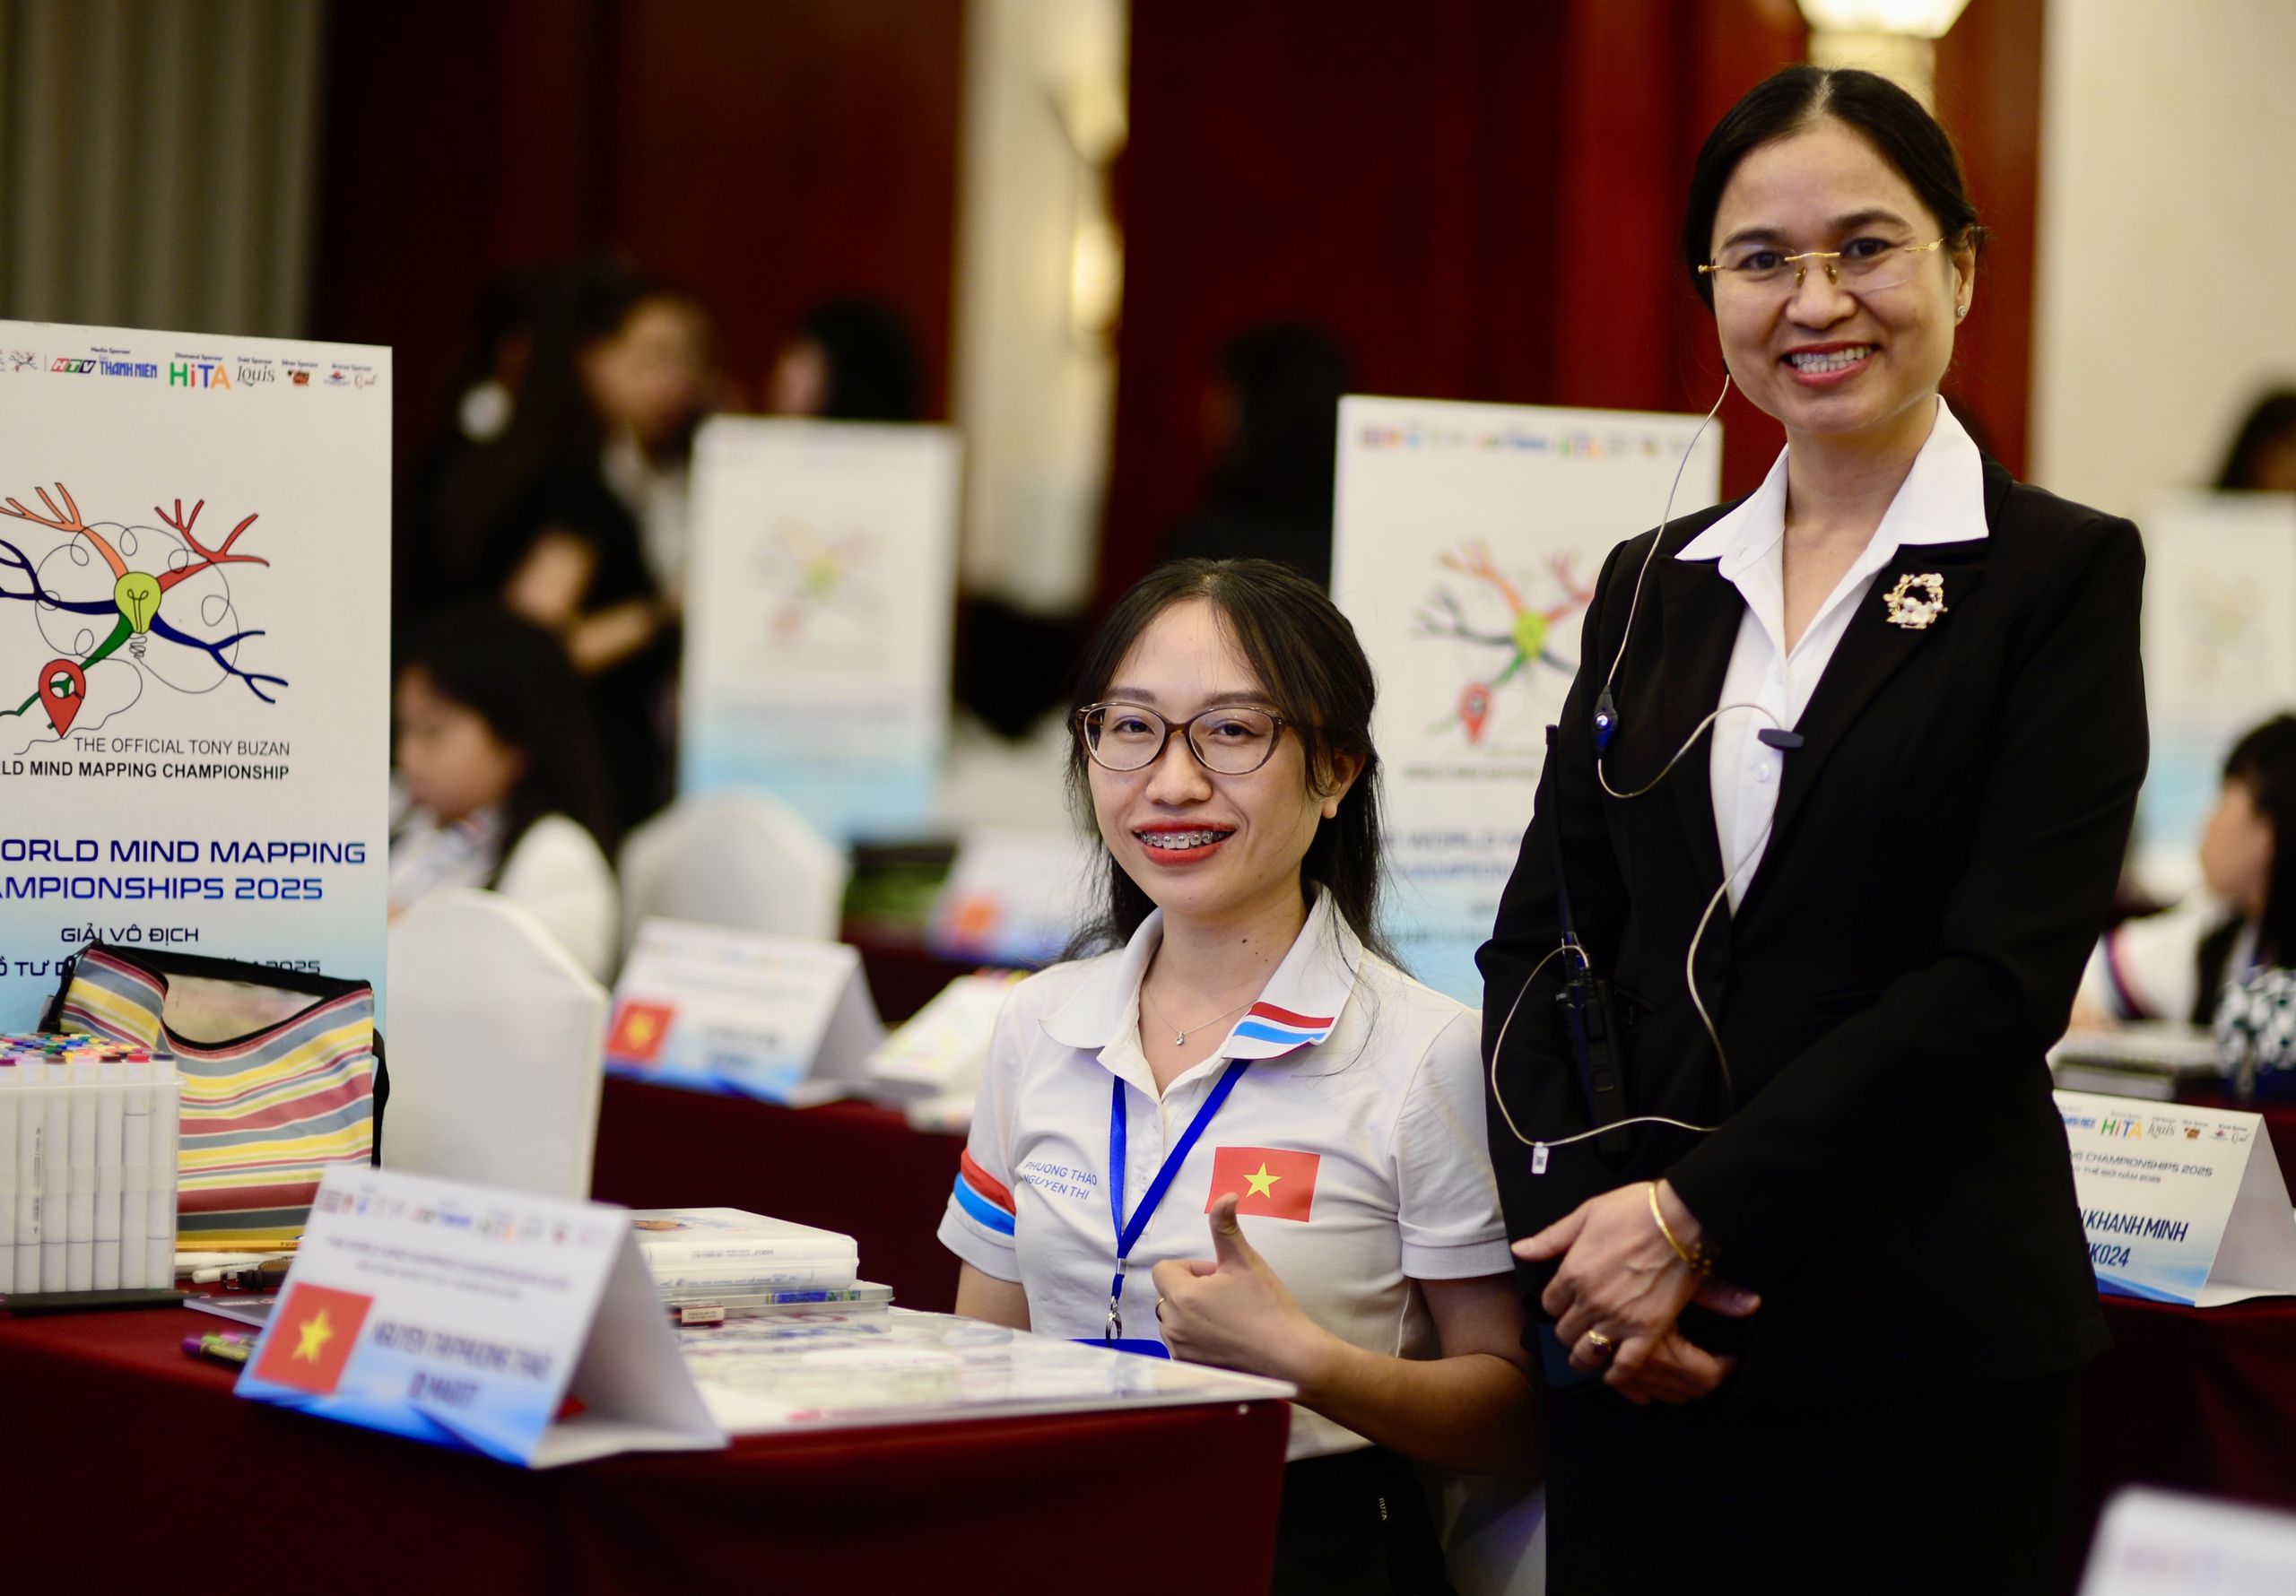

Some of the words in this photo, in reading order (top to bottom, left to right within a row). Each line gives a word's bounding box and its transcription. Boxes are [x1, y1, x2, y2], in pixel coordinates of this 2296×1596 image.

[50, 358, 97, 374] HTV
[100, 360, 134, 377] THANH
[74, 737, 106, 752] THE
[111, 738, 184, 754] OFFICIAL
[188, 740, 233, 755] TONY
[238, 741, 290, 756] BUZAN
[0, 760, 24, 776] LD
[30, 761, 73, 776] MIND
[79, 762, 157, 777] MAPPING
[162, 763, 289, 780] CHAMPIONSHIP
[110, 840, 199, 863] MIND
[211, 841, 366, 863] MAPPING
[0, 877, 224, 899] MPIONSHIPS
[235, 878, 323, 899] 2025
[61, 923, 102, 942] GIẢI
[109, 924, 143, 942] VÔ
[148, 928, 199, 946] ĐỊCH
[14, 959, 49, 976] TƯ
[1024, 1162, 1068, 1177] PHUONG
[1071, 1169, 1098, 1186] THAO
[2085, 1152, 2180, 1174] CHAMPIONSHIPS
[2181, 1164, 2213, 1177] 2025
[1024, 1174, 1068, 1194] NGUYEN
[1070, 1186, 1091, 1200] THI
[2085, 1210, 2145, 1236] KHANH
[2142, 1216, 2190, 1243] MINH
[2090, 1243, 2131, 1268] K024
